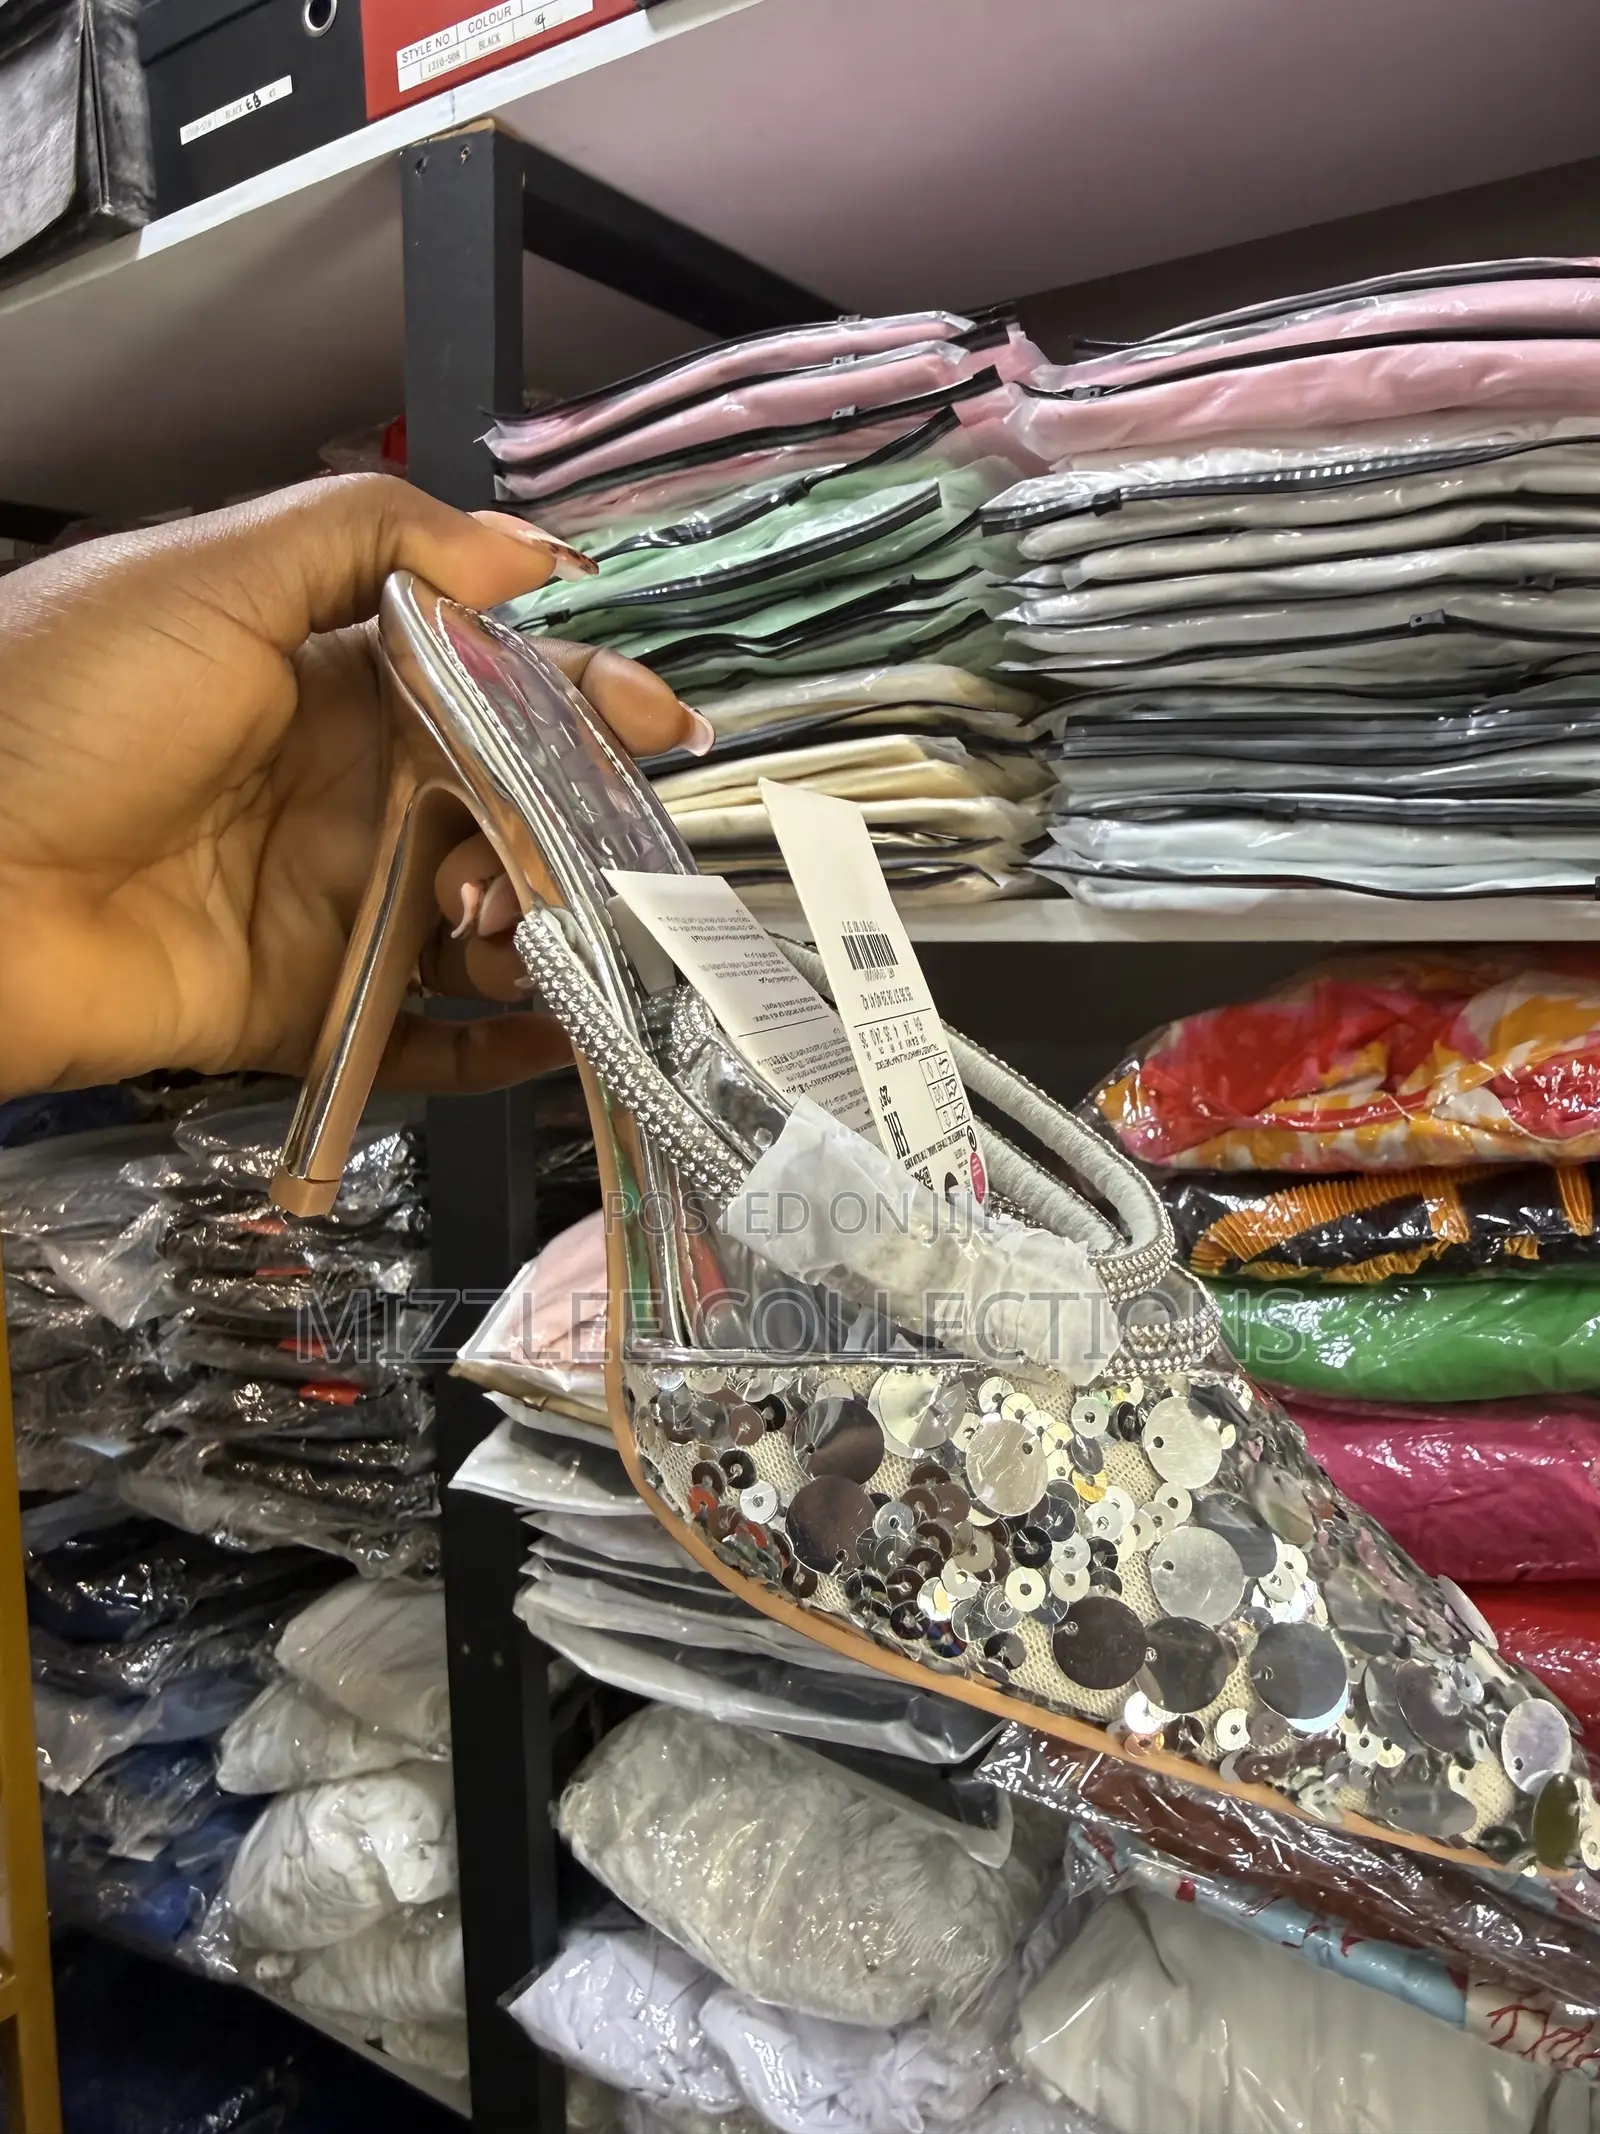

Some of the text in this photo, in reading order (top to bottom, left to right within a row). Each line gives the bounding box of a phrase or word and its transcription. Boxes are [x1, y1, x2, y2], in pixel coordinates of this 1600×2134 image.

[402, 41, 432, 63] STYLE
[468, 5, 512, 33] COLOUR
[478, 33, 502, 51] BLACK
